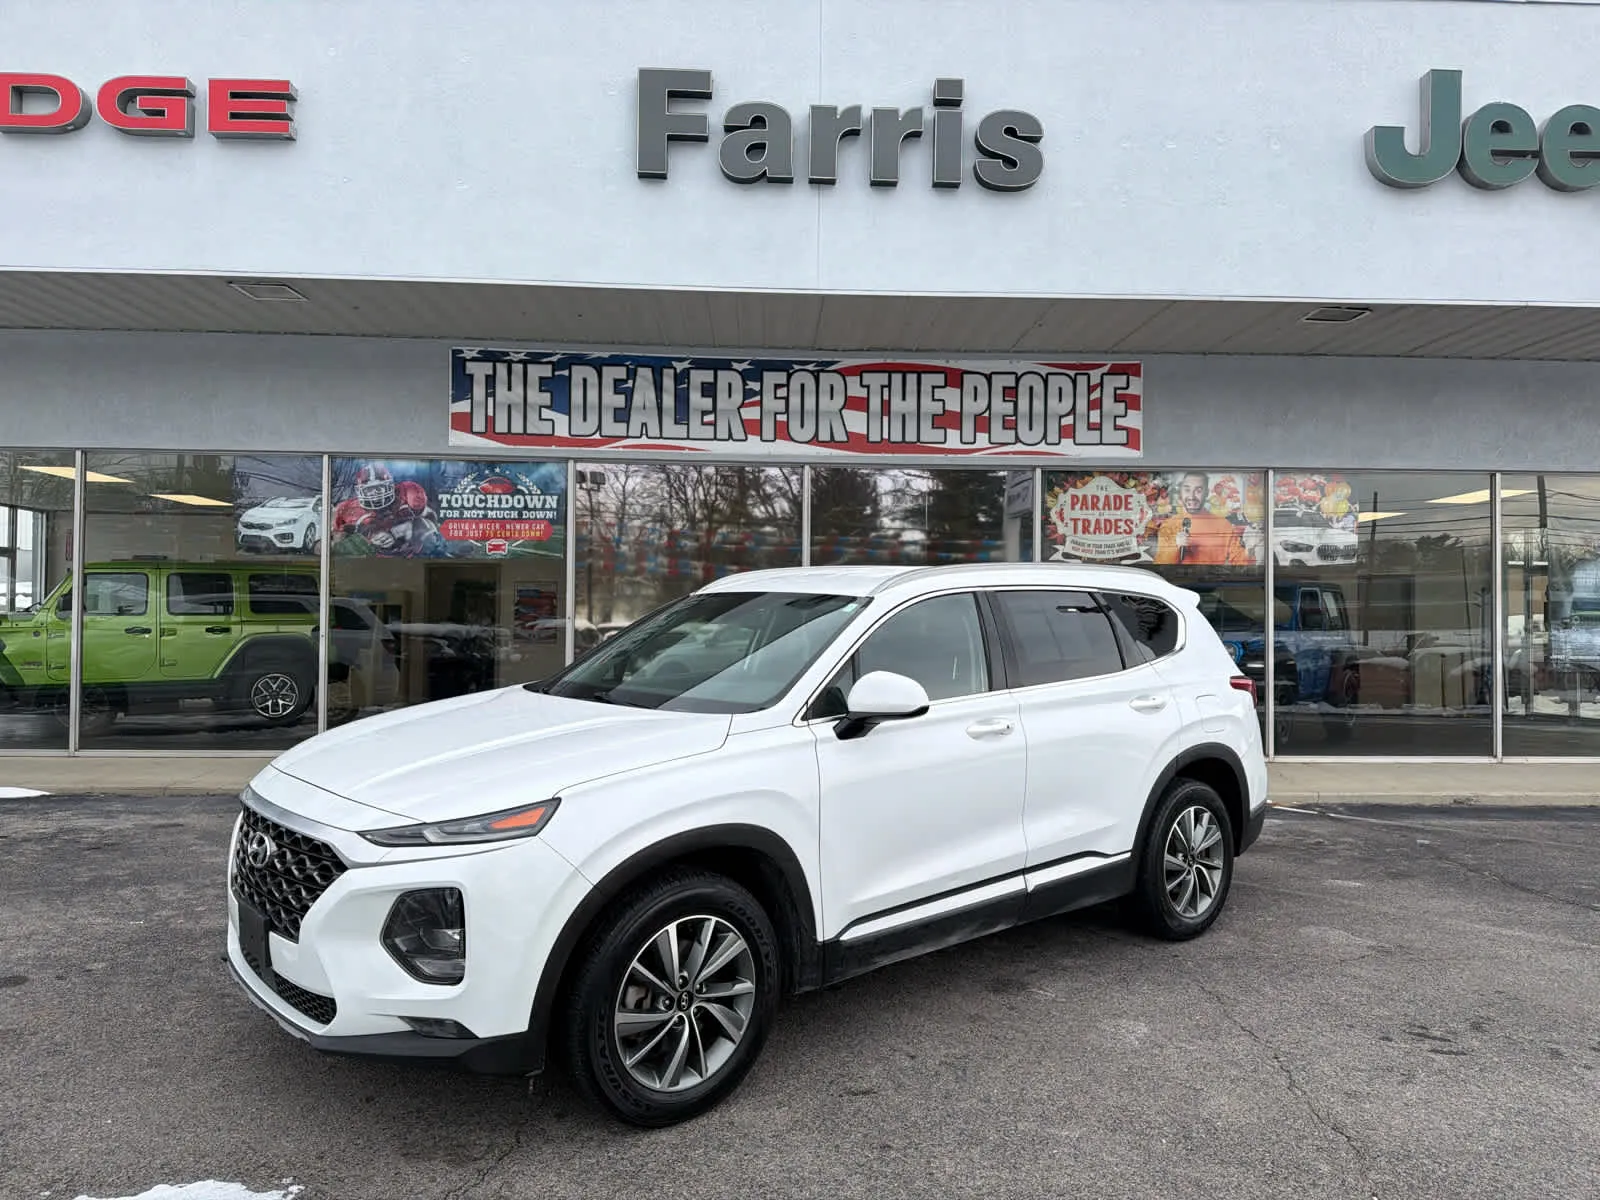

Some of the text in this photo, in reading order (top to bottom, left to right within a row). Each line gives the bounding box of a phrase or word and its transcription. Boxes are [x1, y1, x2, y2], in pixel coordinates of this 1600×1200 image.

[637, 67, 1045, 192] Farris
[464, 360, 1130, 446] THE DEALER FOR THE PEOPLE
[438, 493, 559, 509] TOUCHDOWN
[1070, 494, 1134, 511] PARADE
[439, 509, 557, 520] FOR NOT MUCH DOWN!
[1070, 518, 1134, 536] TRADES
